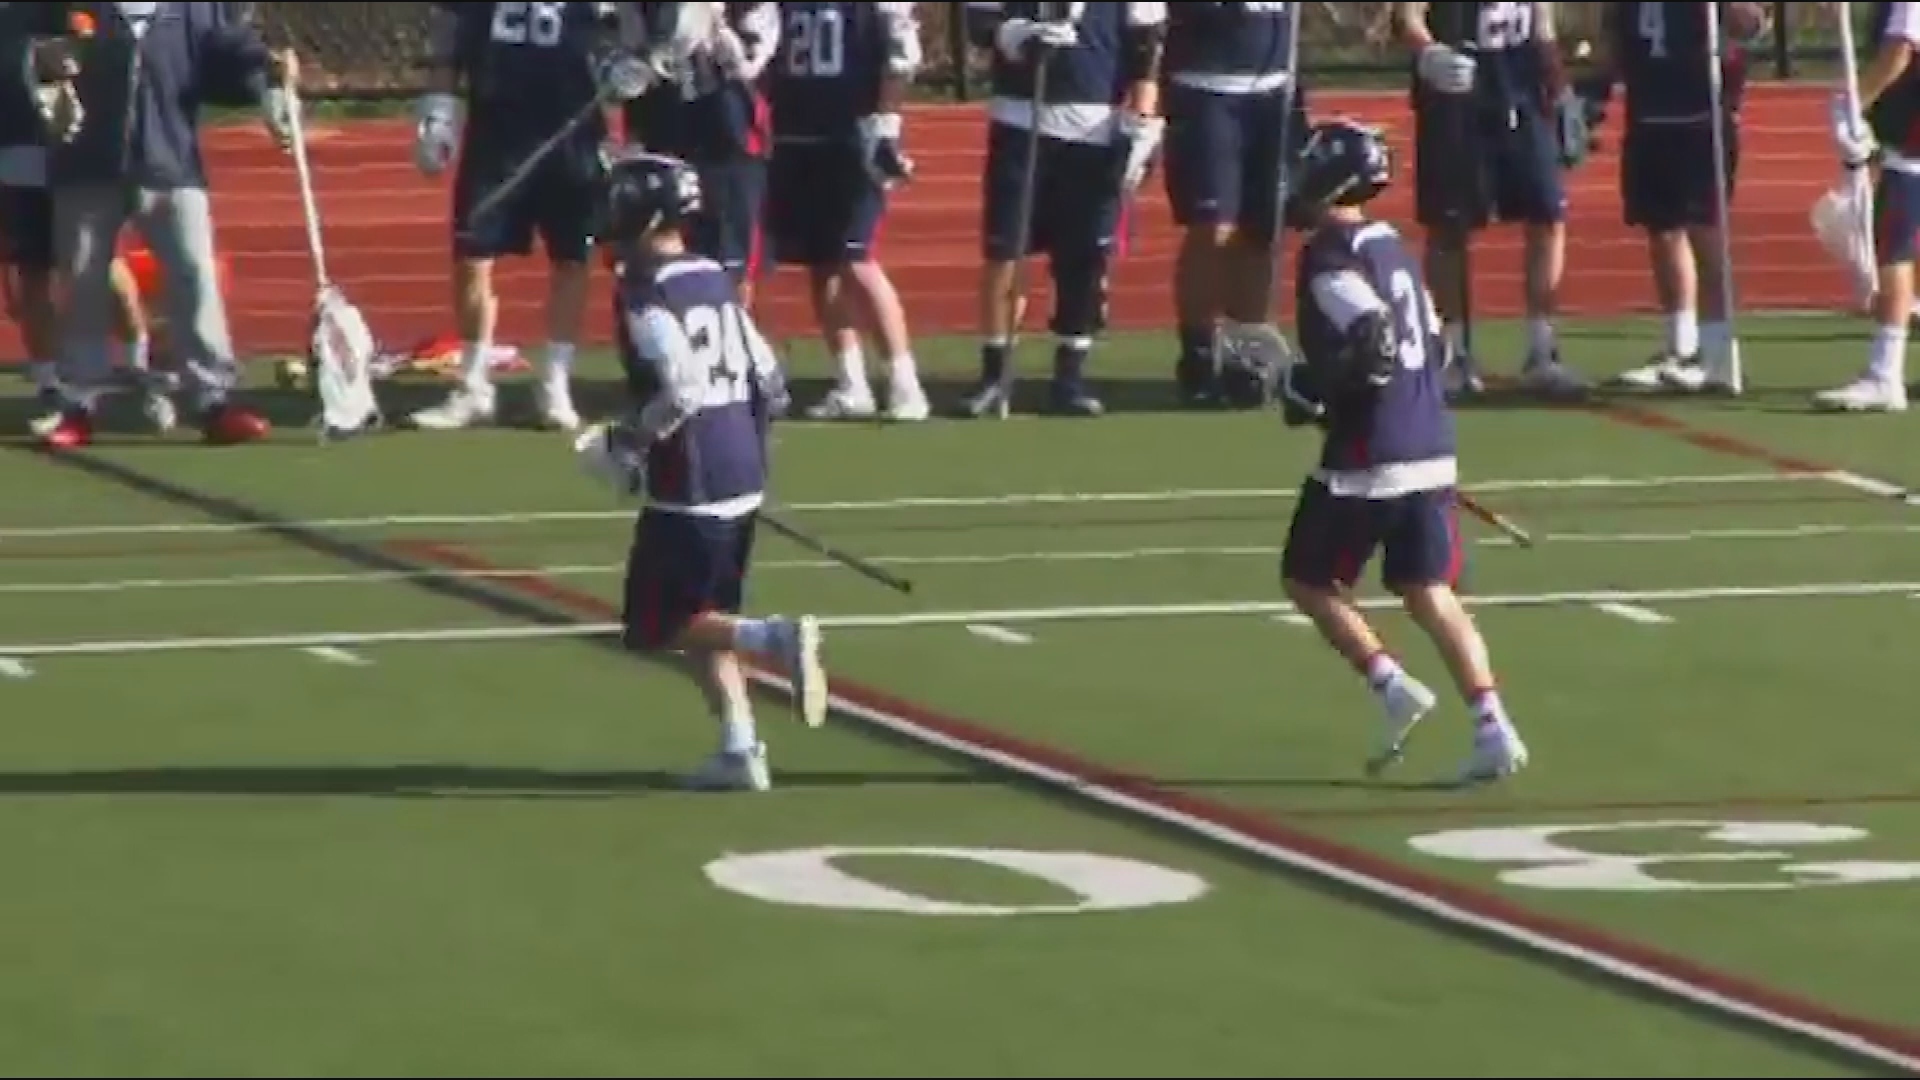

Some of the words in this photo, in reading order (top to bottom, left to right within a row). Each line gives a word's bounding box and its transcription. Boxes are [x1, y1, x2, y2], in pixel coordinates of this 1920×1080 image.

[789, 10, 845, 77] 20
[1638, 2, 1669, 58] 4
[683, 301, 751, 407] 24
